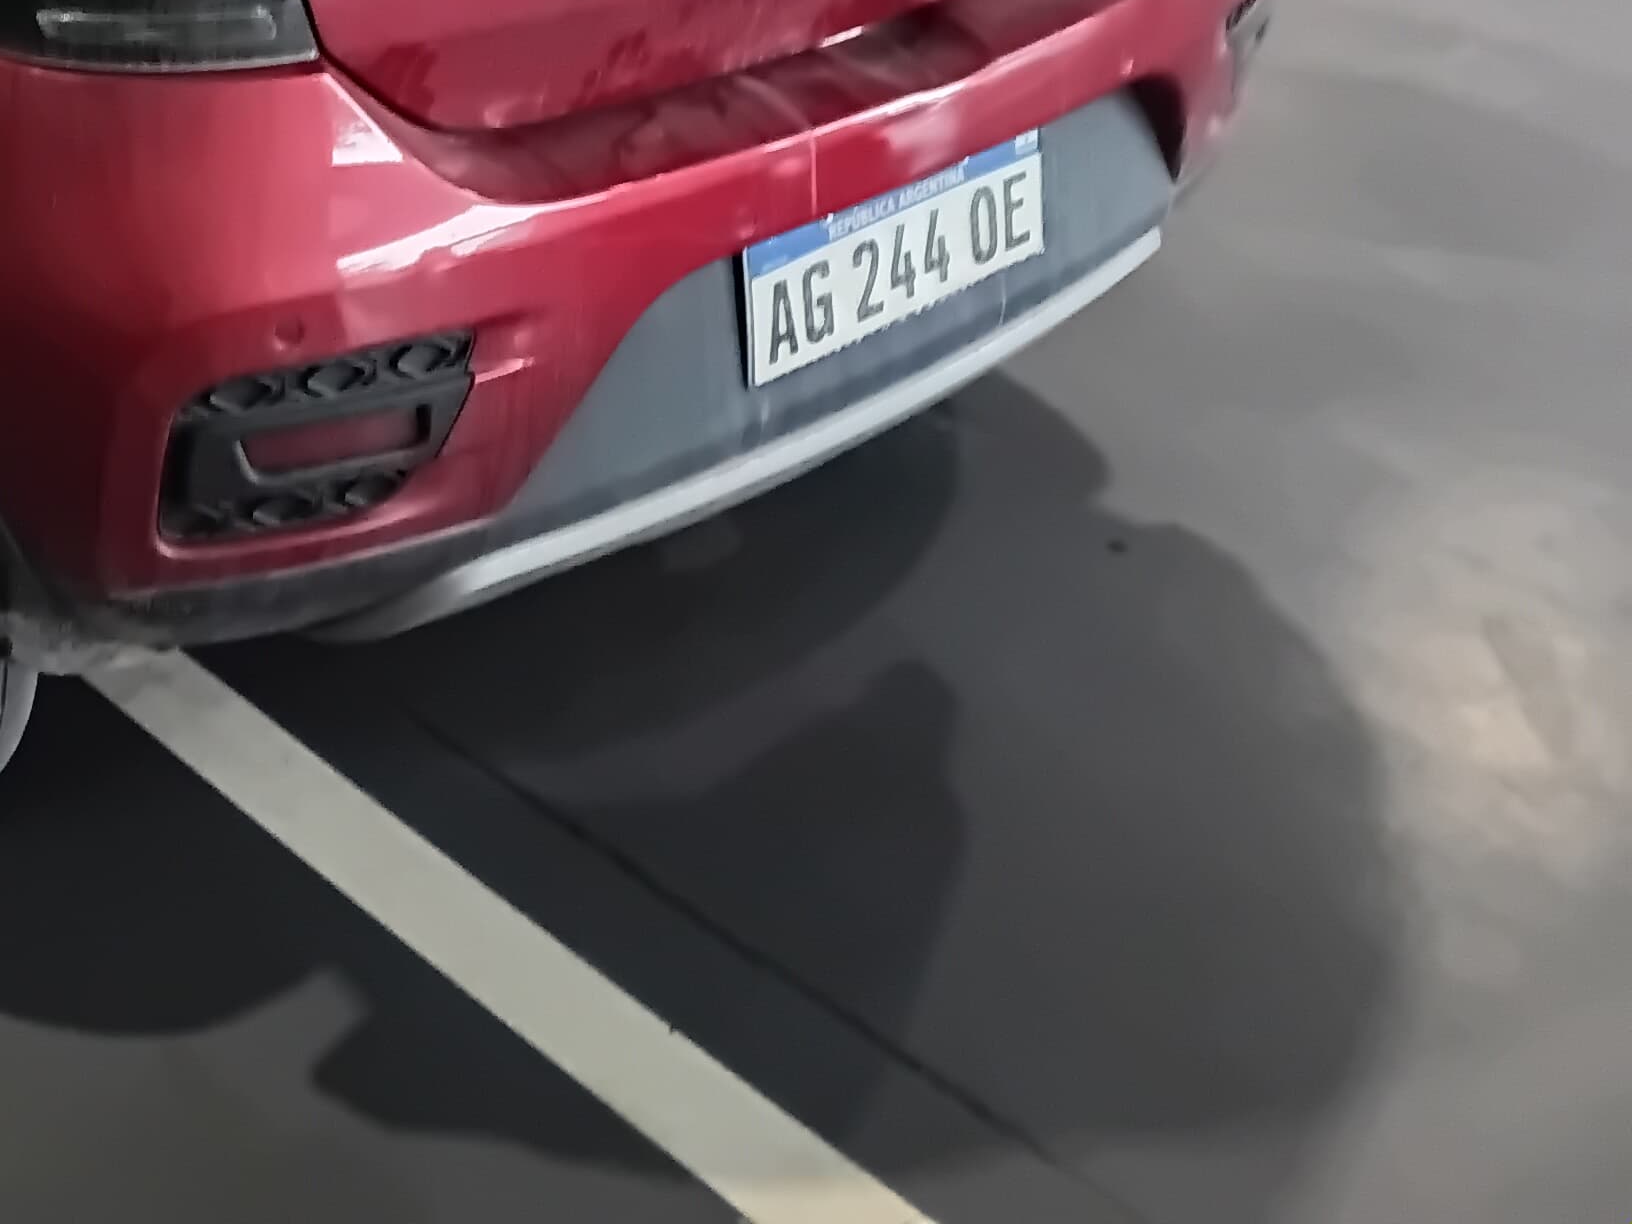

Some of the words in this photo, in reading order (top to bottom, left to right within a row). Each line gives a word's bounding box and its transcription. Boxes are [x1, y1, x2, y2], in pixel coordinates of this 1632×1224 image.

[769, 259, 835, 366] AG
[852, 207, 951, 324] 244
[969, 171, 1032, 266] OE
